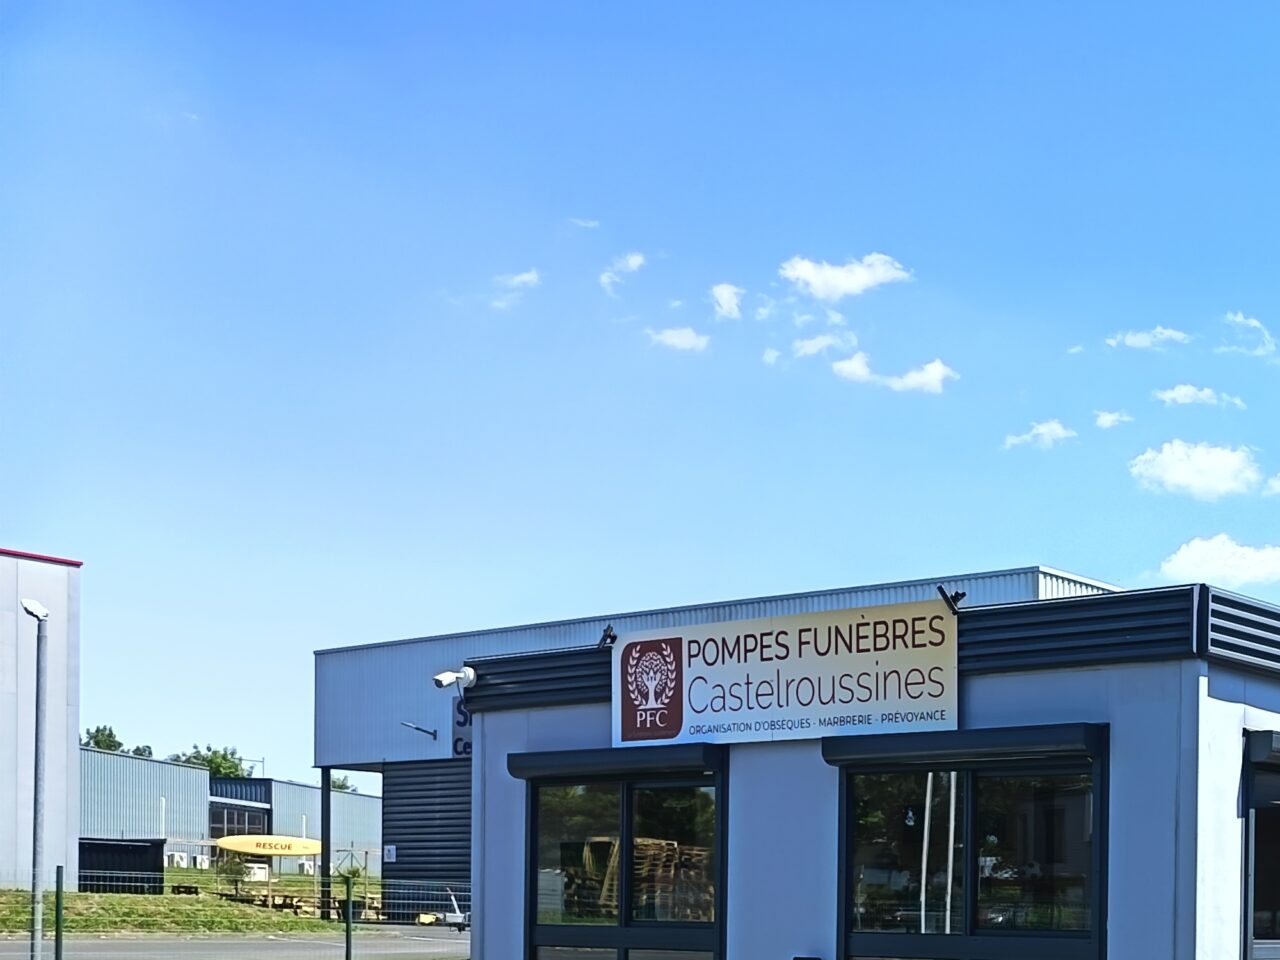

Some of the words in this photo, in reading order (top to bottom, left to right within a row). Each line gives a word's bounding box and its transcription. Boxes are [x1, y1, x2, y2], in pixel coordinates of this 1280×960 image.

[687, 630, 790, 669] POMPES
[797, 615, 946, 658] FUNÈBRES
[687, 660, 946, 714] Castelroussines
[636, 709, 668, 728] PFC
[688, 721, 752, 735] ORGANISATION
[818, 713, 872, 726] MARBRERIE
[880, 708, 946, 724] PRÉVOYANCE
[255, 841, 293, 851] RESCUE
